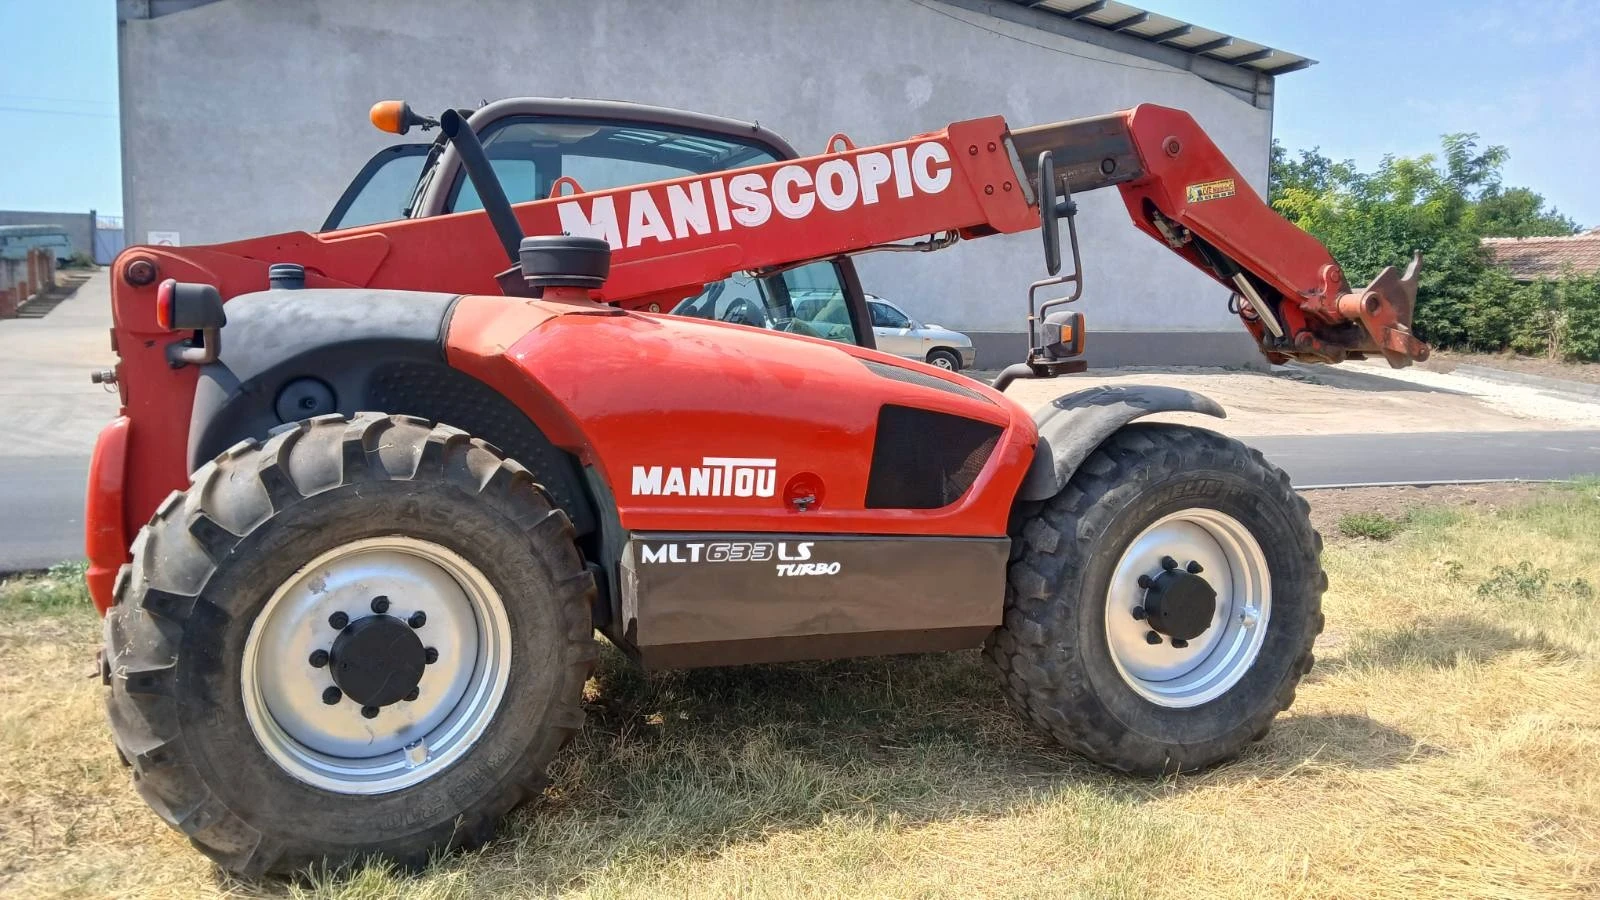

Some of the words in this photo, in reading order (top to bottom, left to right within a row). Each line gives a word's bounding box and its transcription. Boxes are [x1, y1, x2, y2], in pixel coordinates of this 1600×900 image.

[556, 141, 952, 251] MANISCOPIC
[631, 456, 777, 498] MANITOU
[775, 561, 841, 577] TURBO
